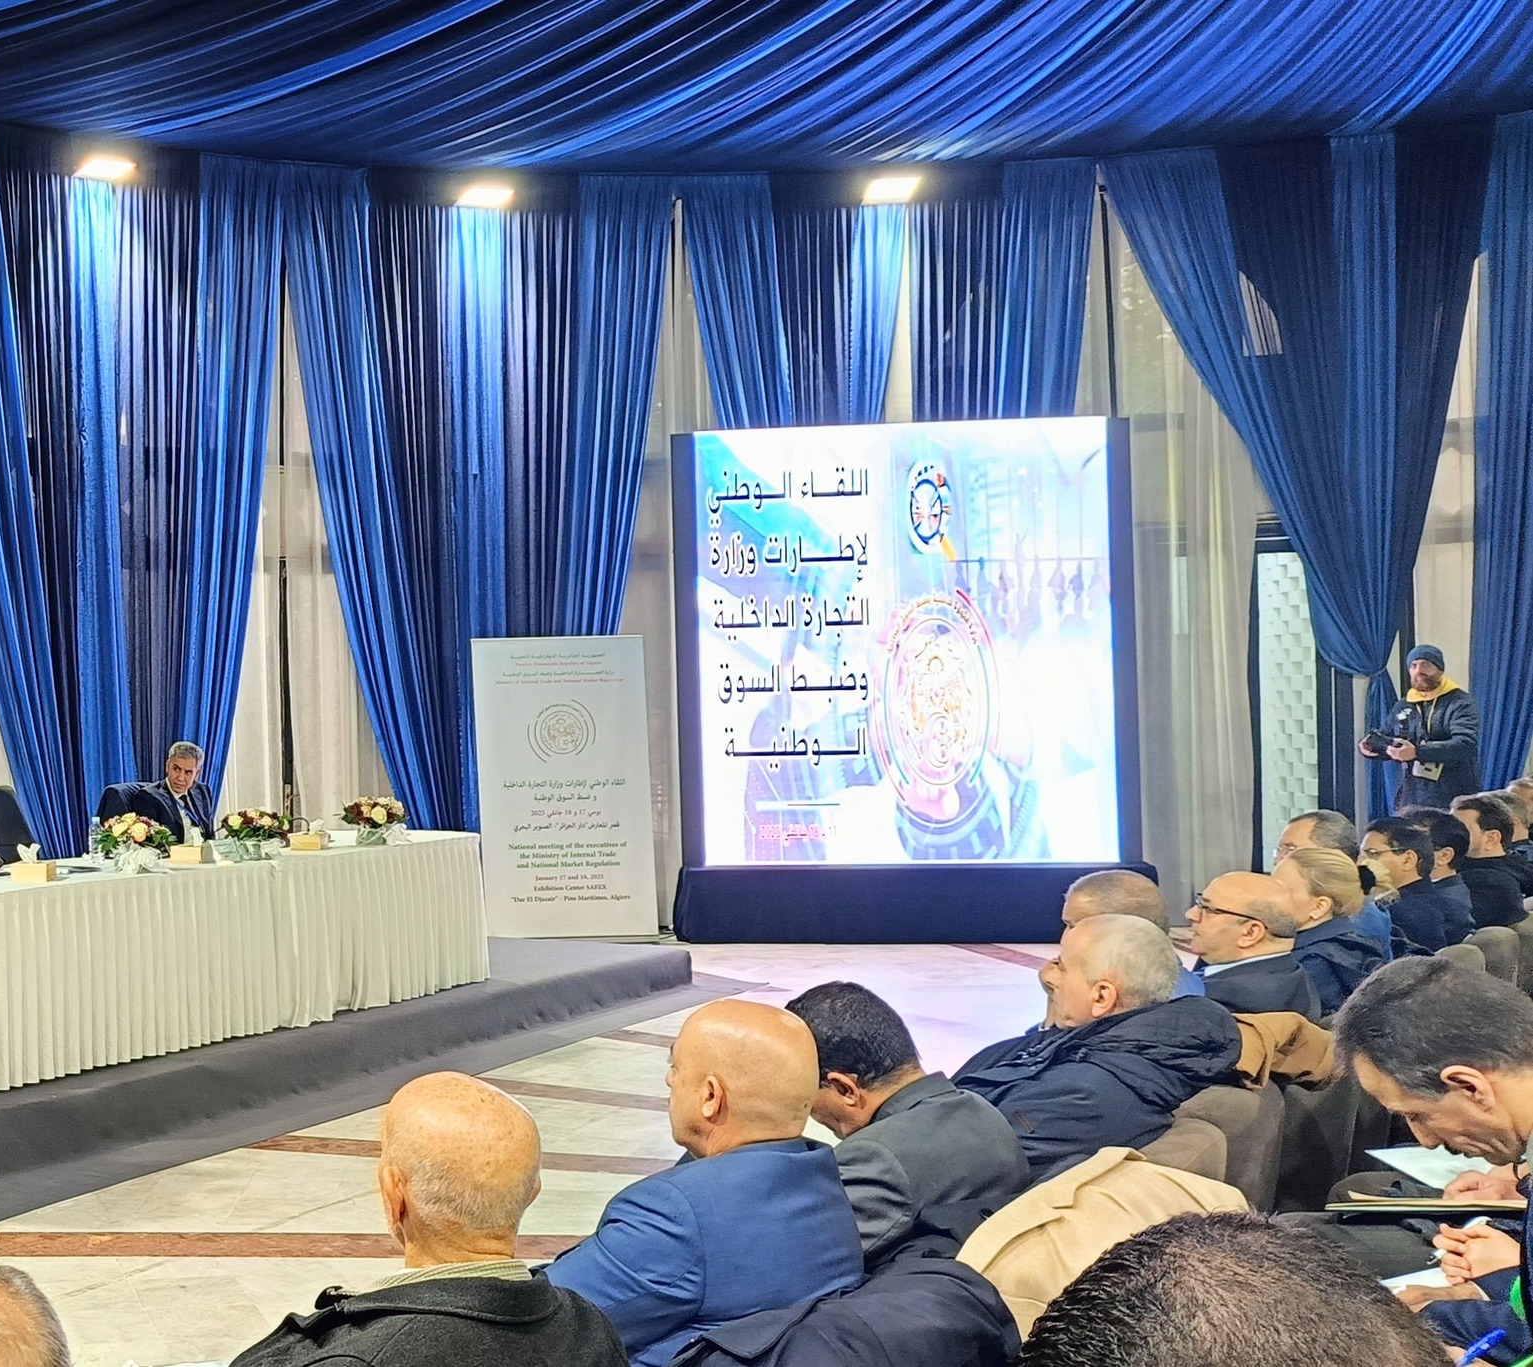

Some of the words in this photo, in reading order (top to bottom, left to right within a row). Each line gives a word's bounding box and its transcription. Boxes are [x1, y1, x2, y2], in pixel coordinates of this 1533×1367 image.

[714, 598, 795, 641] الداخلية
[801, 595, 869, 638] التجارة
[718, 663, 780, 704] السوق
[790, 661, 868, 703] وضبط
[725, 726, 866, 769] الوطنية
[532, 852, 560, 860] Ministry
[538, 843, 564, 851] meeting
[585, 860, 621, 868] Regulation
